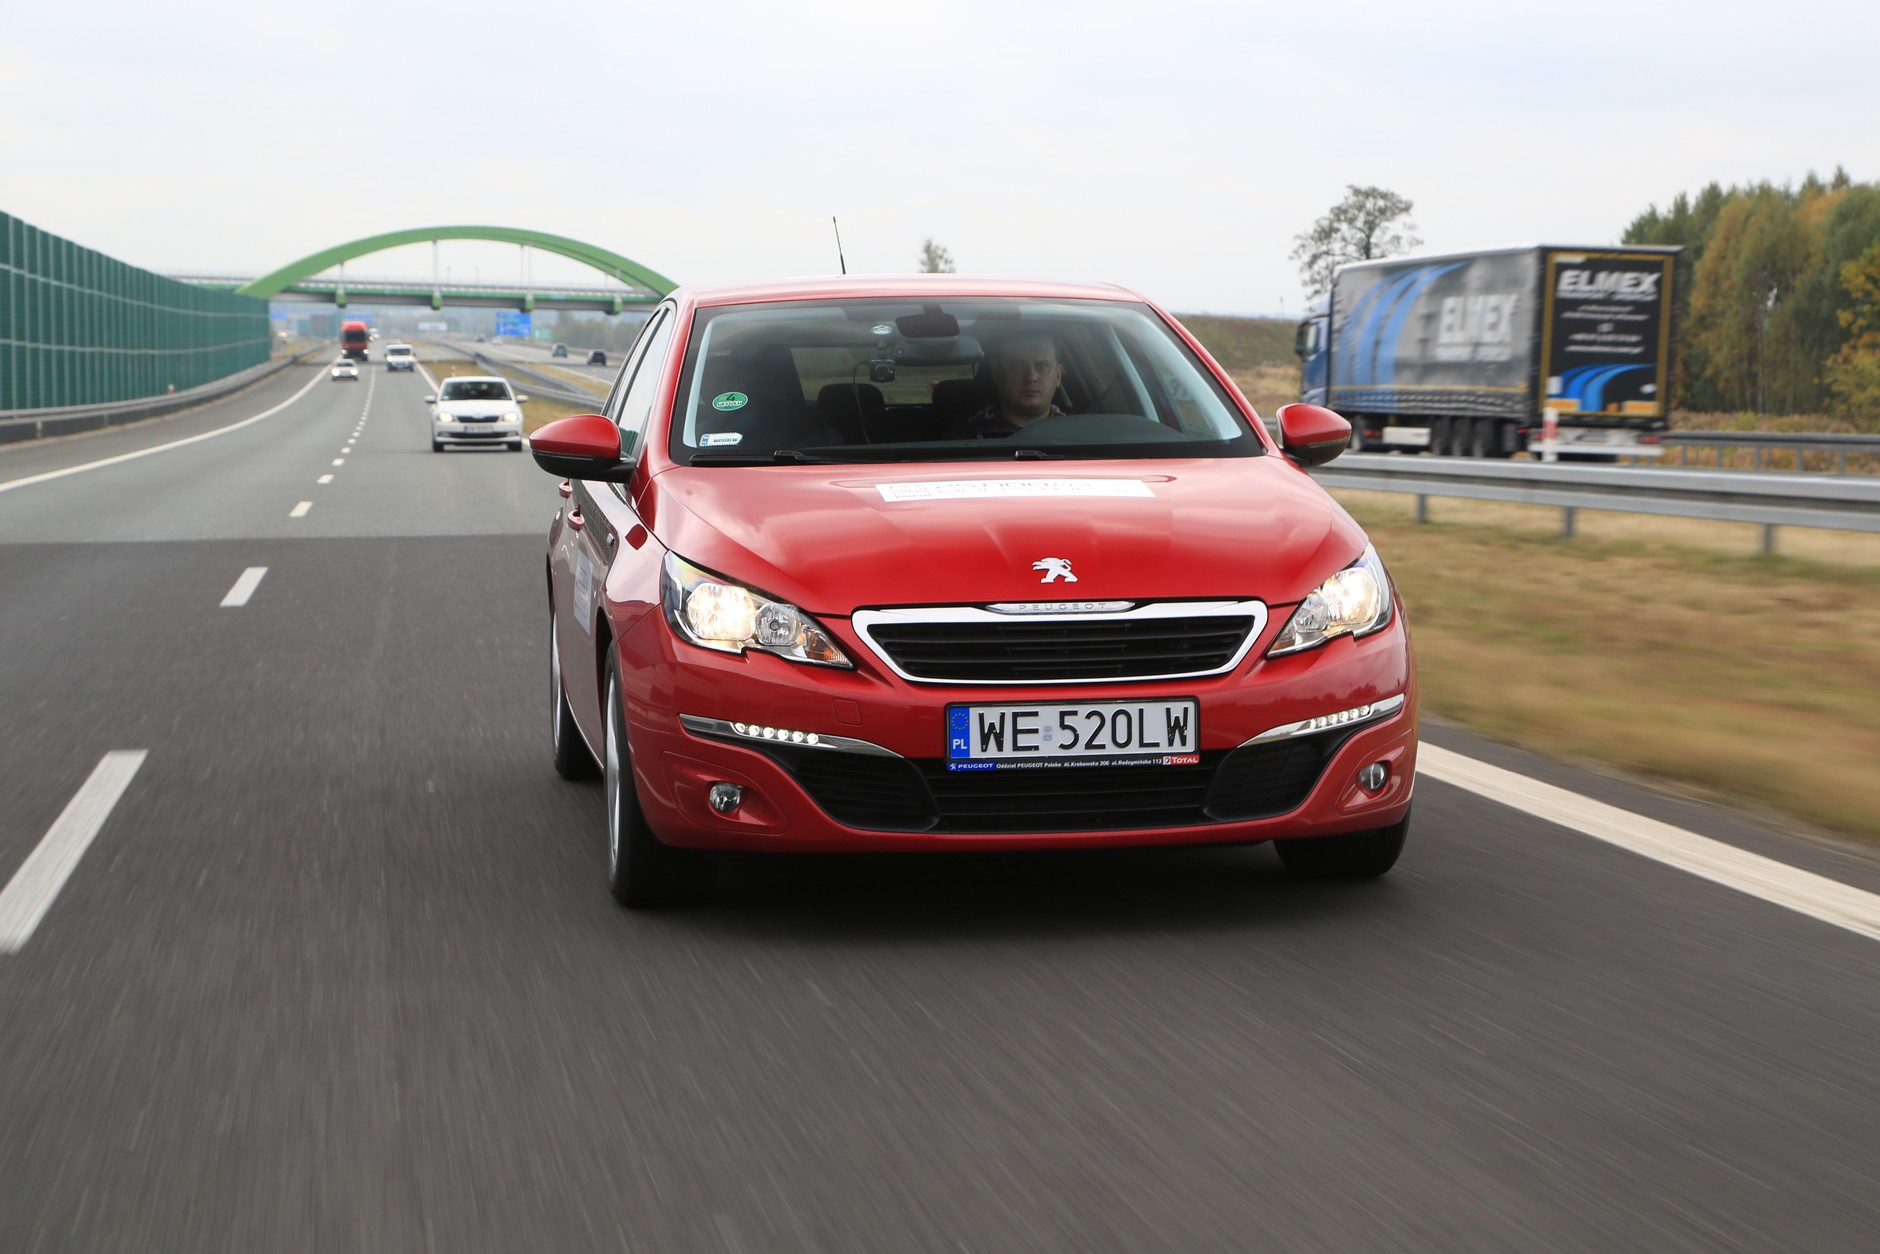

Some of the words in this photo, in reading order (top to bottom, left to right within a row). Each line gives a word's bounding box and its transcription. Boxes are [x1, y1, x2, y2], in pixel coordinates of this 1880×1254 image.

[1557, 270, 1661, 293] ELMEX
[1019, 603, 1106, 611] PEUGEOT
[978, 711, 1039, 752] WE
[1058, 707, 1188, 750] 520LW
[953, 739, 967, 750] PL
[1171, 756, 1199, 764] TOTAL
